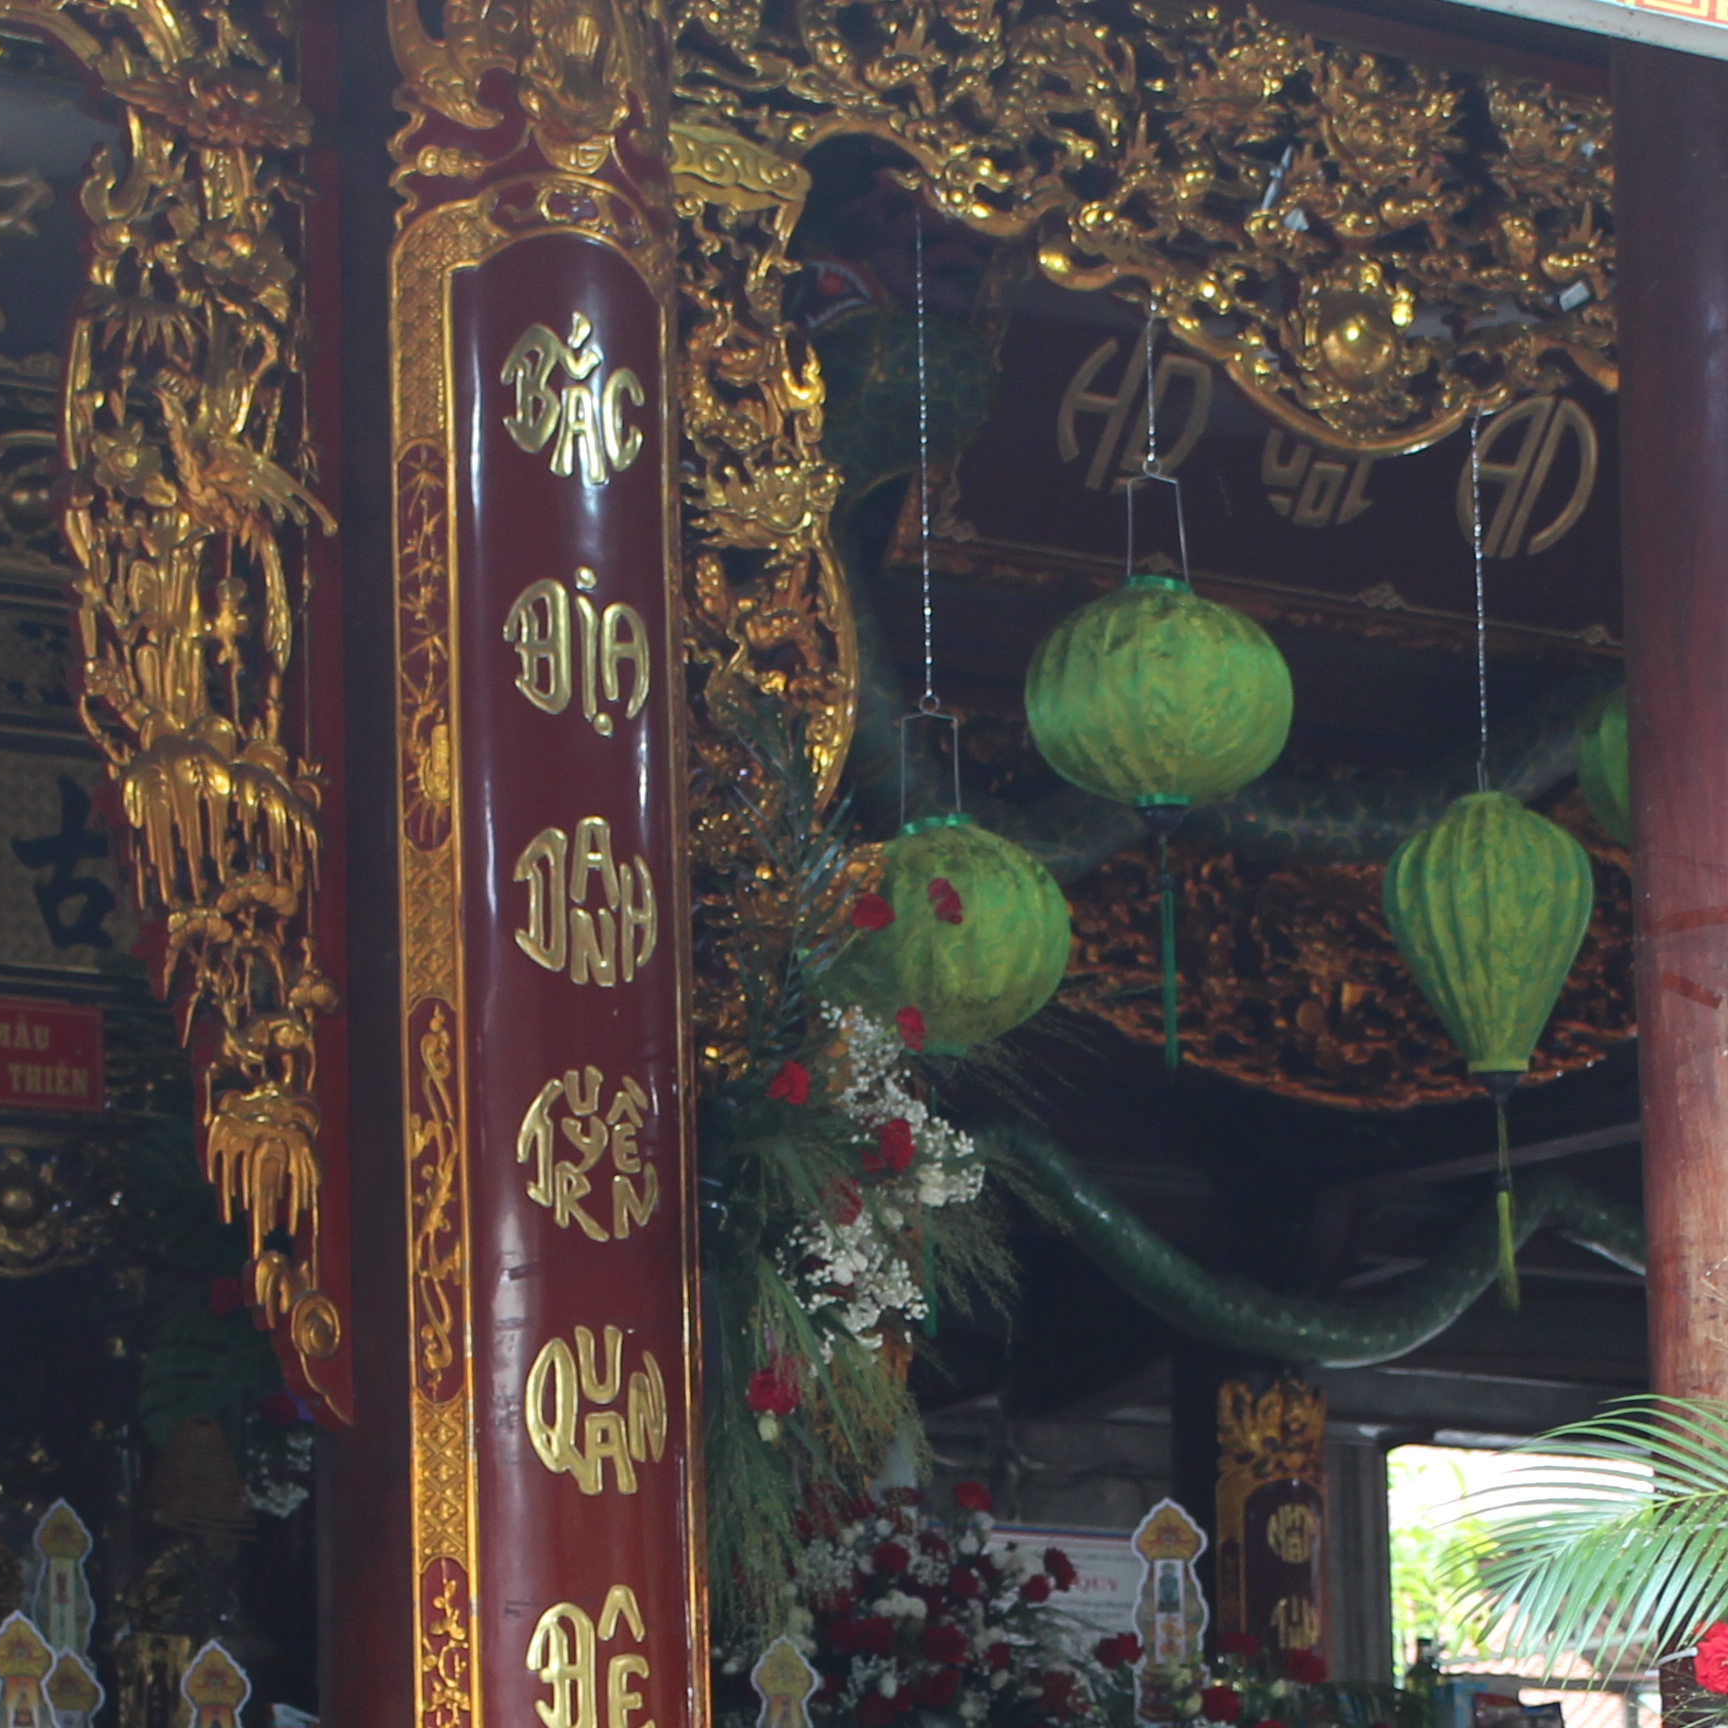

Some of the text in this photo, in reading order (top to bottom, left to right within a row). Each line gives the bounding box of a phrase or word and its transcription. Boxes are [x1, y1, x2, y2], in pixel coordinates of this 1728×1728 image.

[502, 311, 645, 485] BẮC
[502, 567, 650, 736] ĐỊA
[514, 815, 656, 987] DANH
[525, 1324, 667, 1494] QUAN
